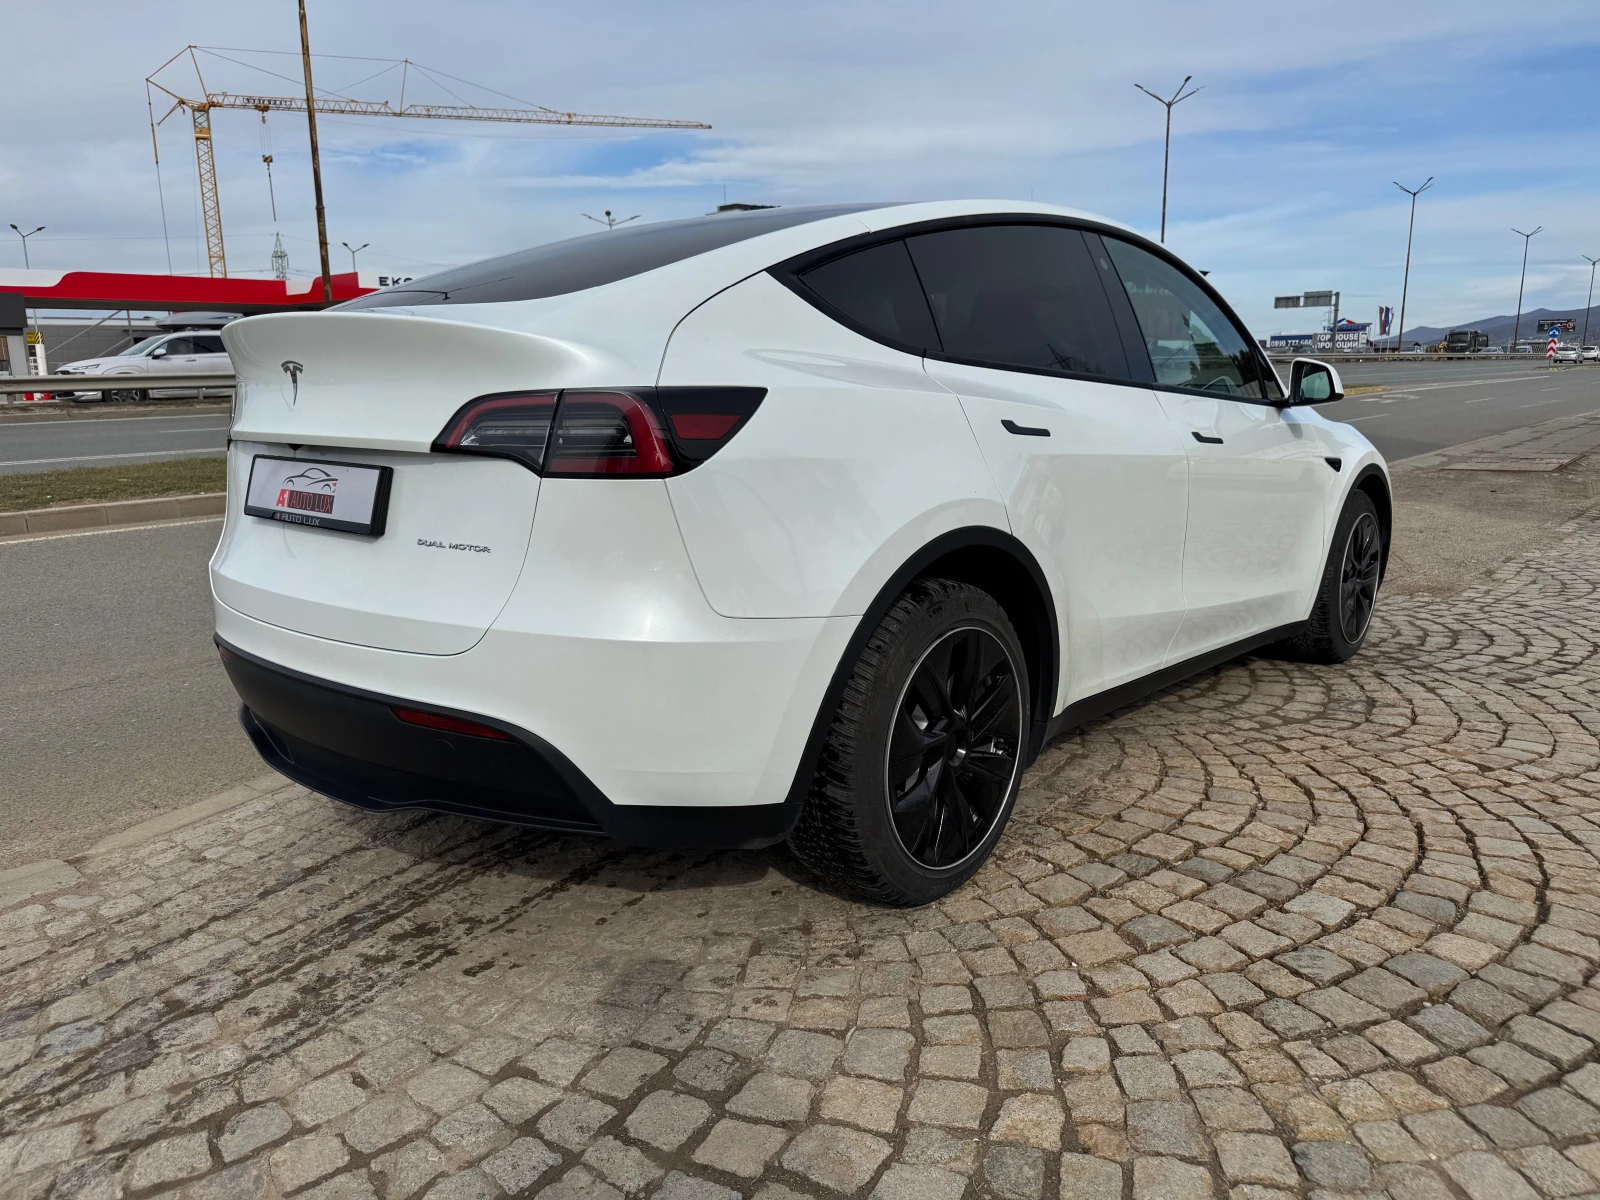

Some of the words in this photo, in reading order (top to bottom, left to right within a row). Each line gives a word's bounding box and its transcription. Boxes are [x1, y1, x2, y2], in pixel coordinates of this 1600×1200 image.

[1315, 341, 1359, 349] ПРООЦИИ
[290, 491, 313, 510] AUTO
[314, 494, 334, 514] LUX
[281, 513, 302, 523] AUTO
[303, 517, 321, 526] LUX
[416, 538, 446, 548] DUAL
[448, 542, 491, 553] MOTOR
